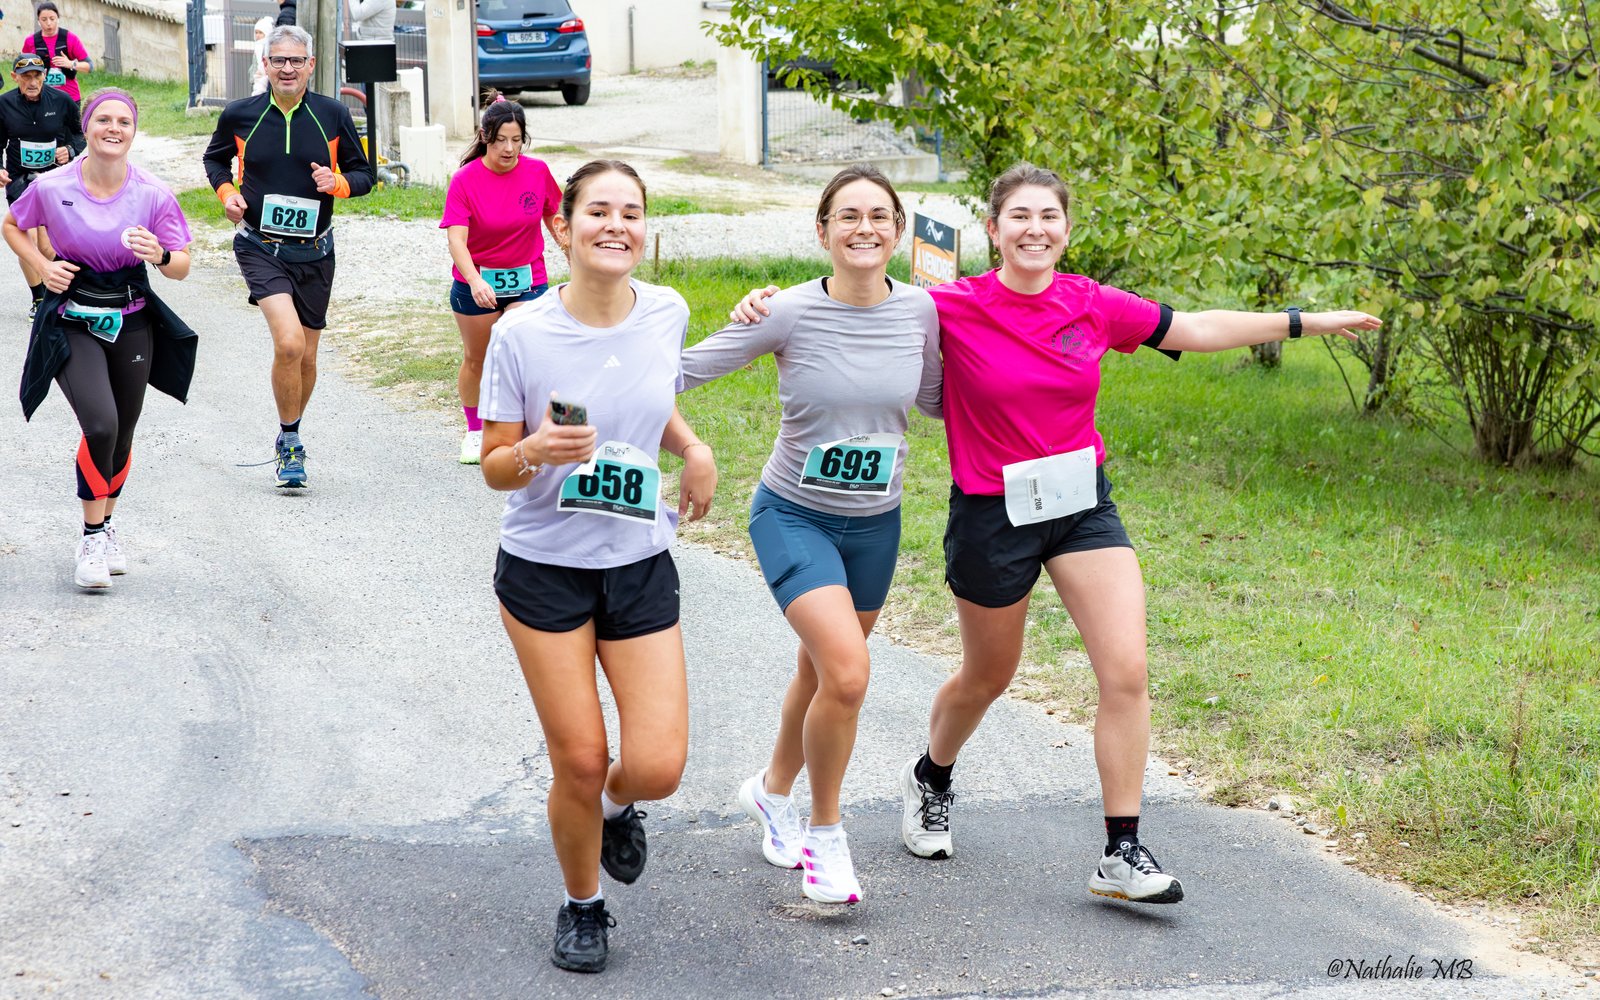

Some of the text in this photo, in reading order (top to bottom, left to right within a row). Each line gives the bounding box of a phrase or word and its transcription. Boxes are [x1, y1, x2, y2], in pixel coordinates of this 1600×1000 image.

[25, 150, 52, 163] 528
[272, 206, 308, 229] 628
[921, 248, 955, 283] VENDRE
[494, 270, 519, 290] 53
[820, 447, 882, 481] 693
[578, 463, 644, 505] 658
[1034, 497, 1043, 511] 208
